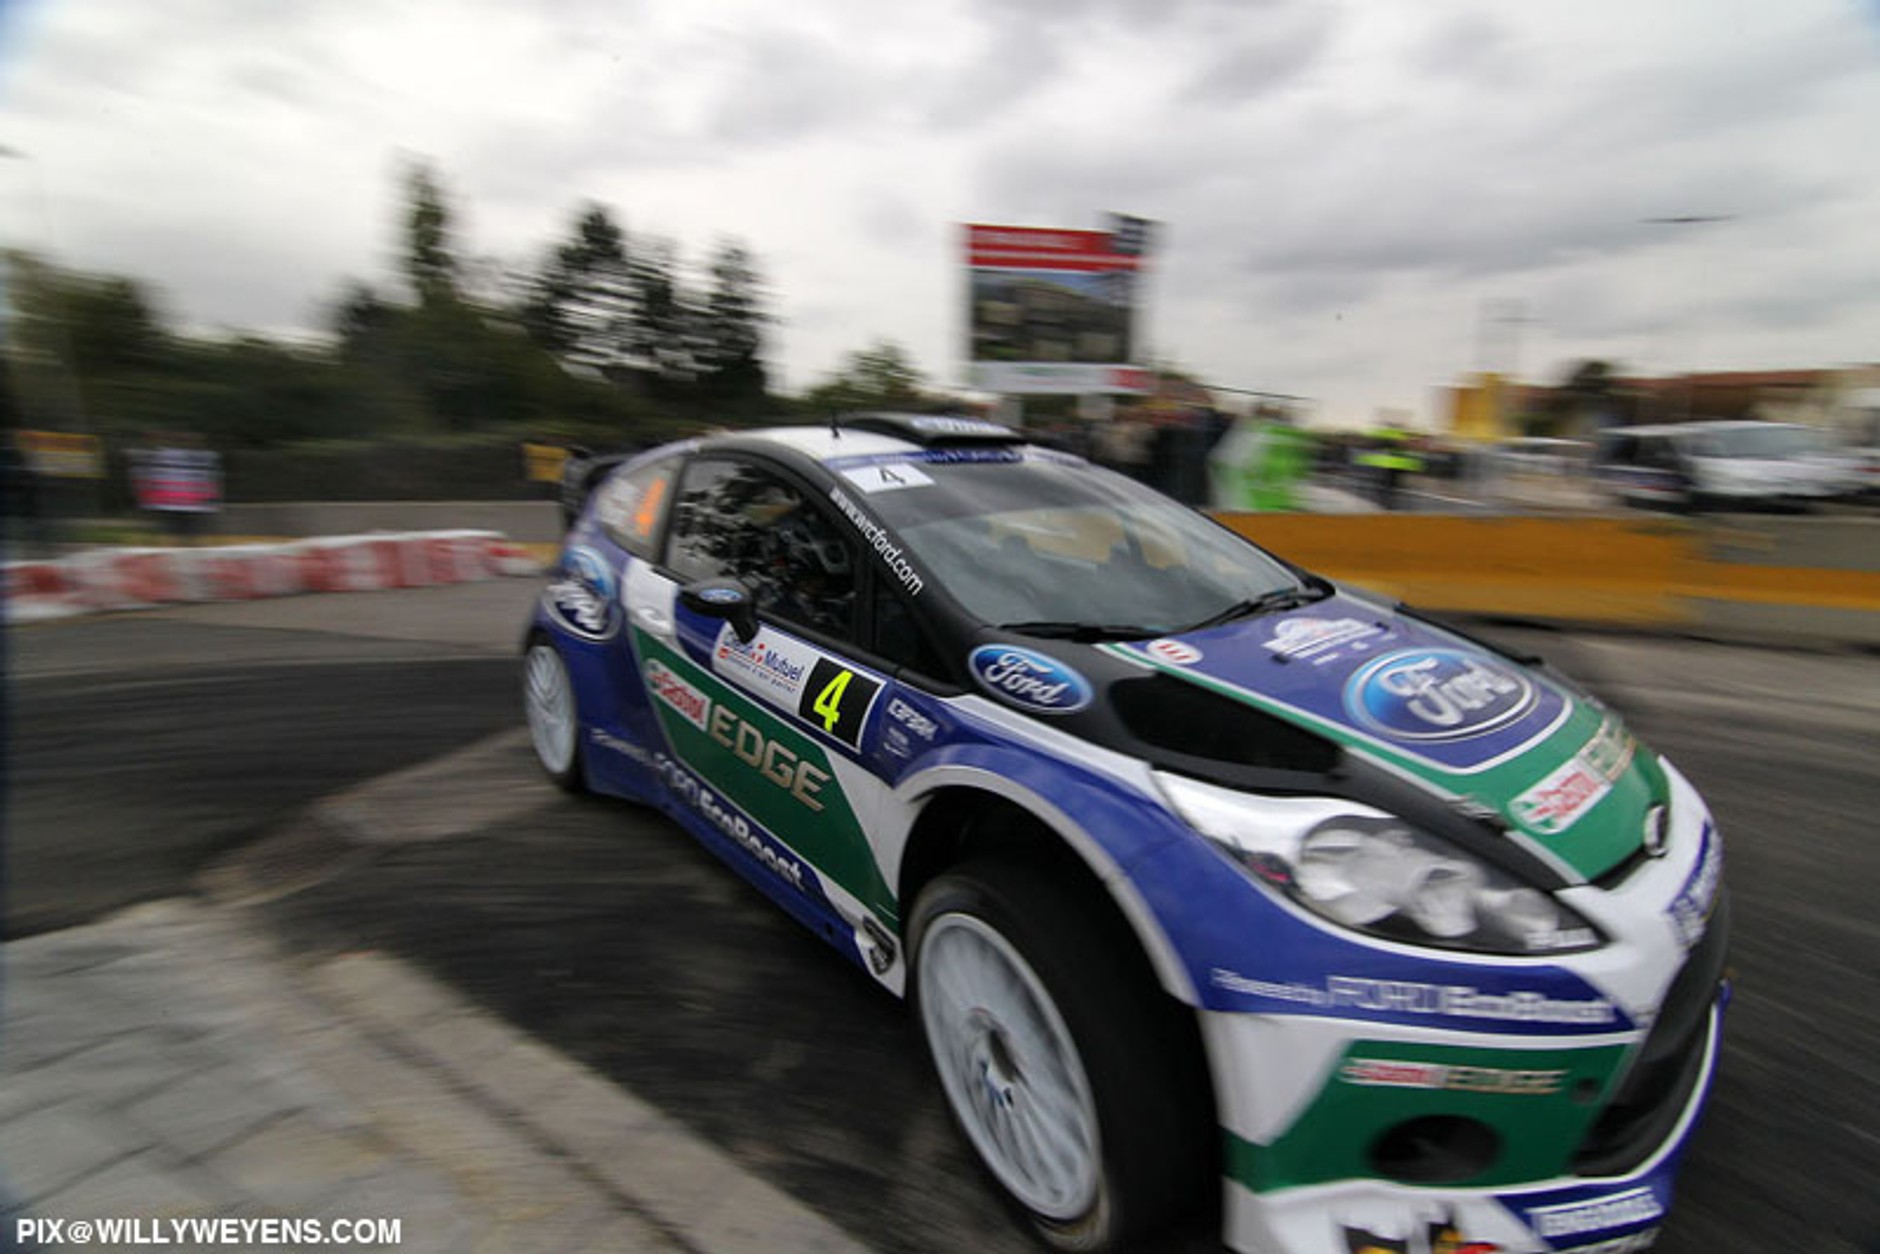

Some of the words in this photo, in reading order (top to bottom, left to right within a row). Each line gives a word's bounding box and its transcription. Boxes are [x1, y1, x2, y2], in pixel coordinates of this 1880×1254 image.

[879, 468, 906, 484] 4
[813, 670, 854, 733] 4
[984, 652, 1070, 706] Ford
[1378, 656, 1518, 726] Ford
[707, 704, 833, 812] EDGE
